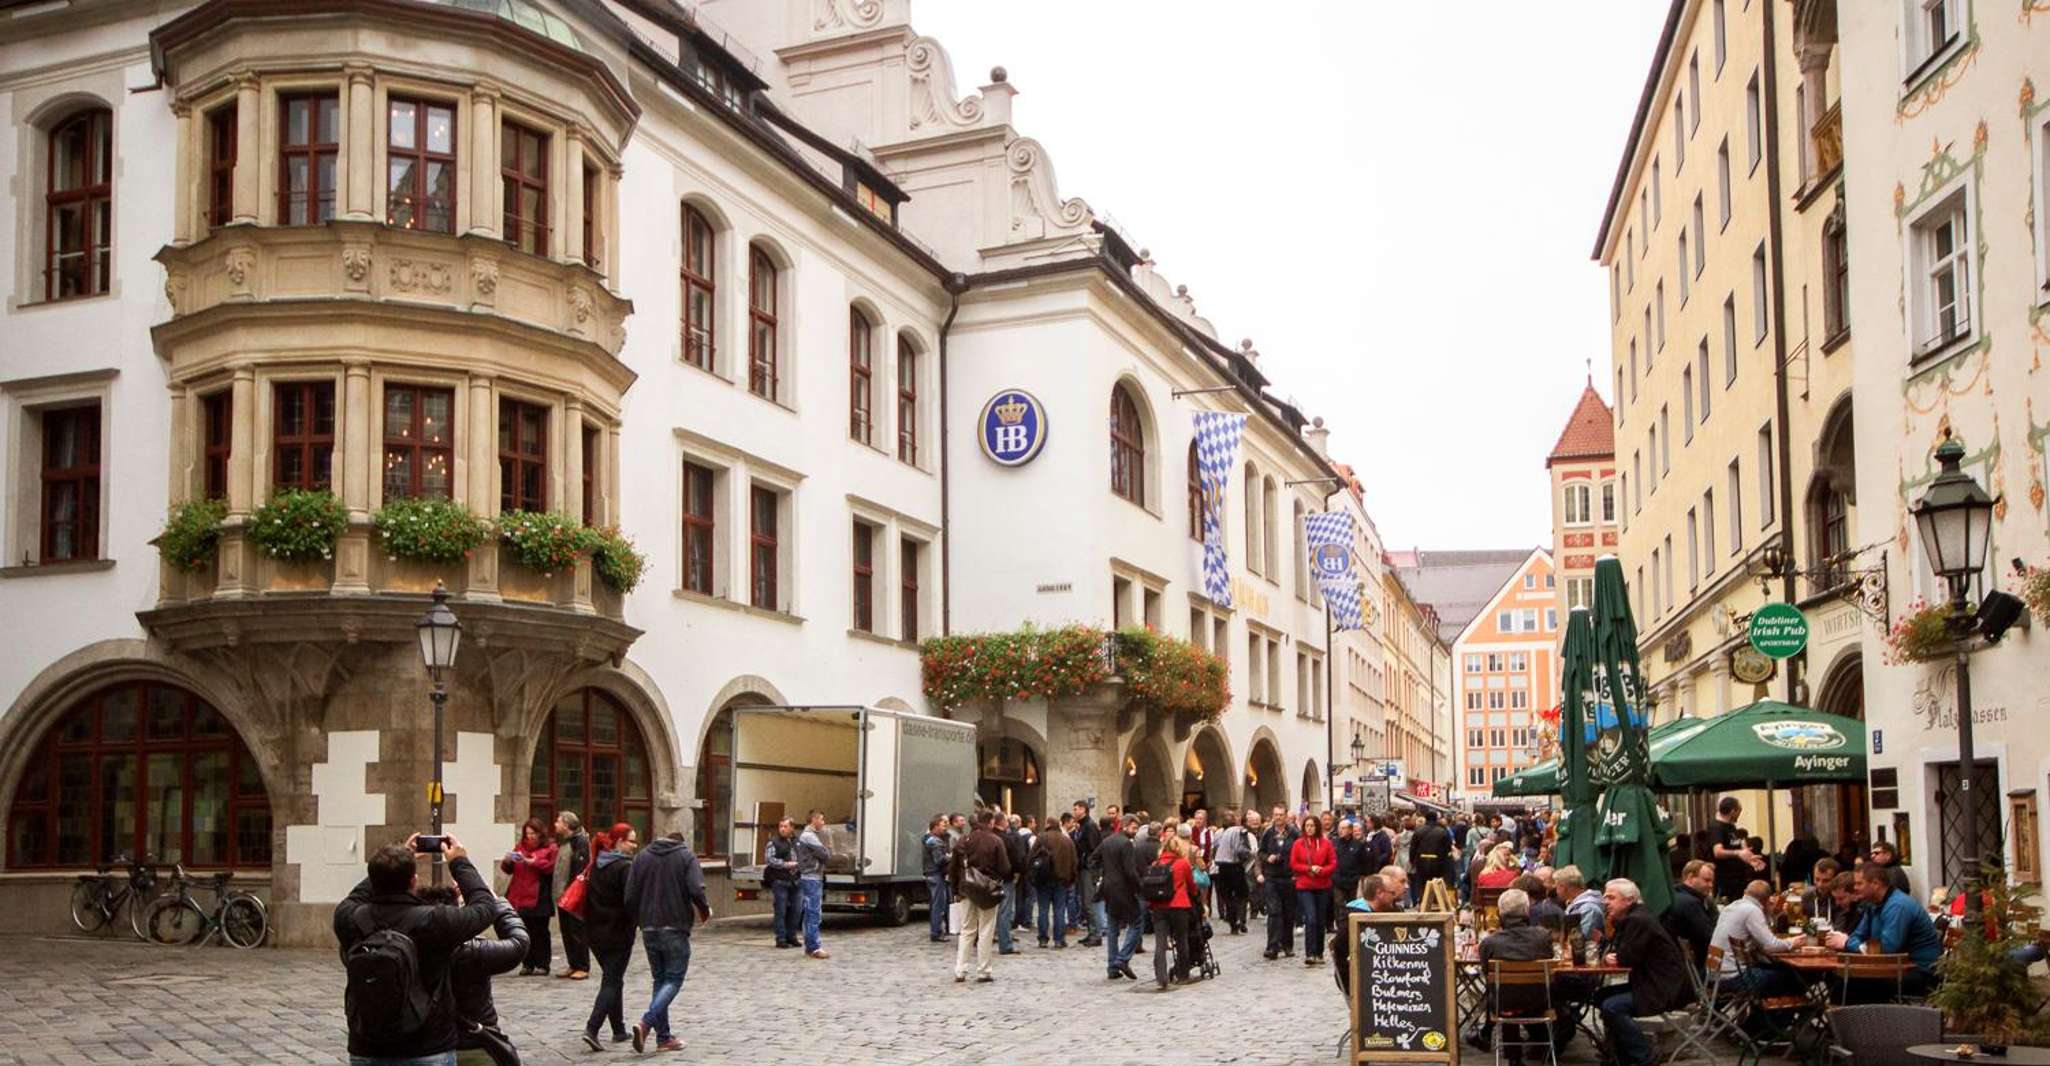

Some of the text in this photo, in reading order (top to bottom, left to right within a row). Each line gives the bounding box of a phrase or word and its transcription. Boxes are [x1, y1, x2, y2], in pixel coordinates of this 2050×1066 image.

[995, 425, 1027, 453] HB
[1757, 616, 1800, 625] Dubliner
[1753, 626, 1806, 636] Irish Pub
[1794, 755, 1850, 771] Ayinger
[1375, 942, 1428, 954] GUINNESS
[1373, 954, 1429, 972] Kilkenny
[1372, 985, 1423, 1001] Bulmers
[1374, 1014, 1416, 1031] Helles
